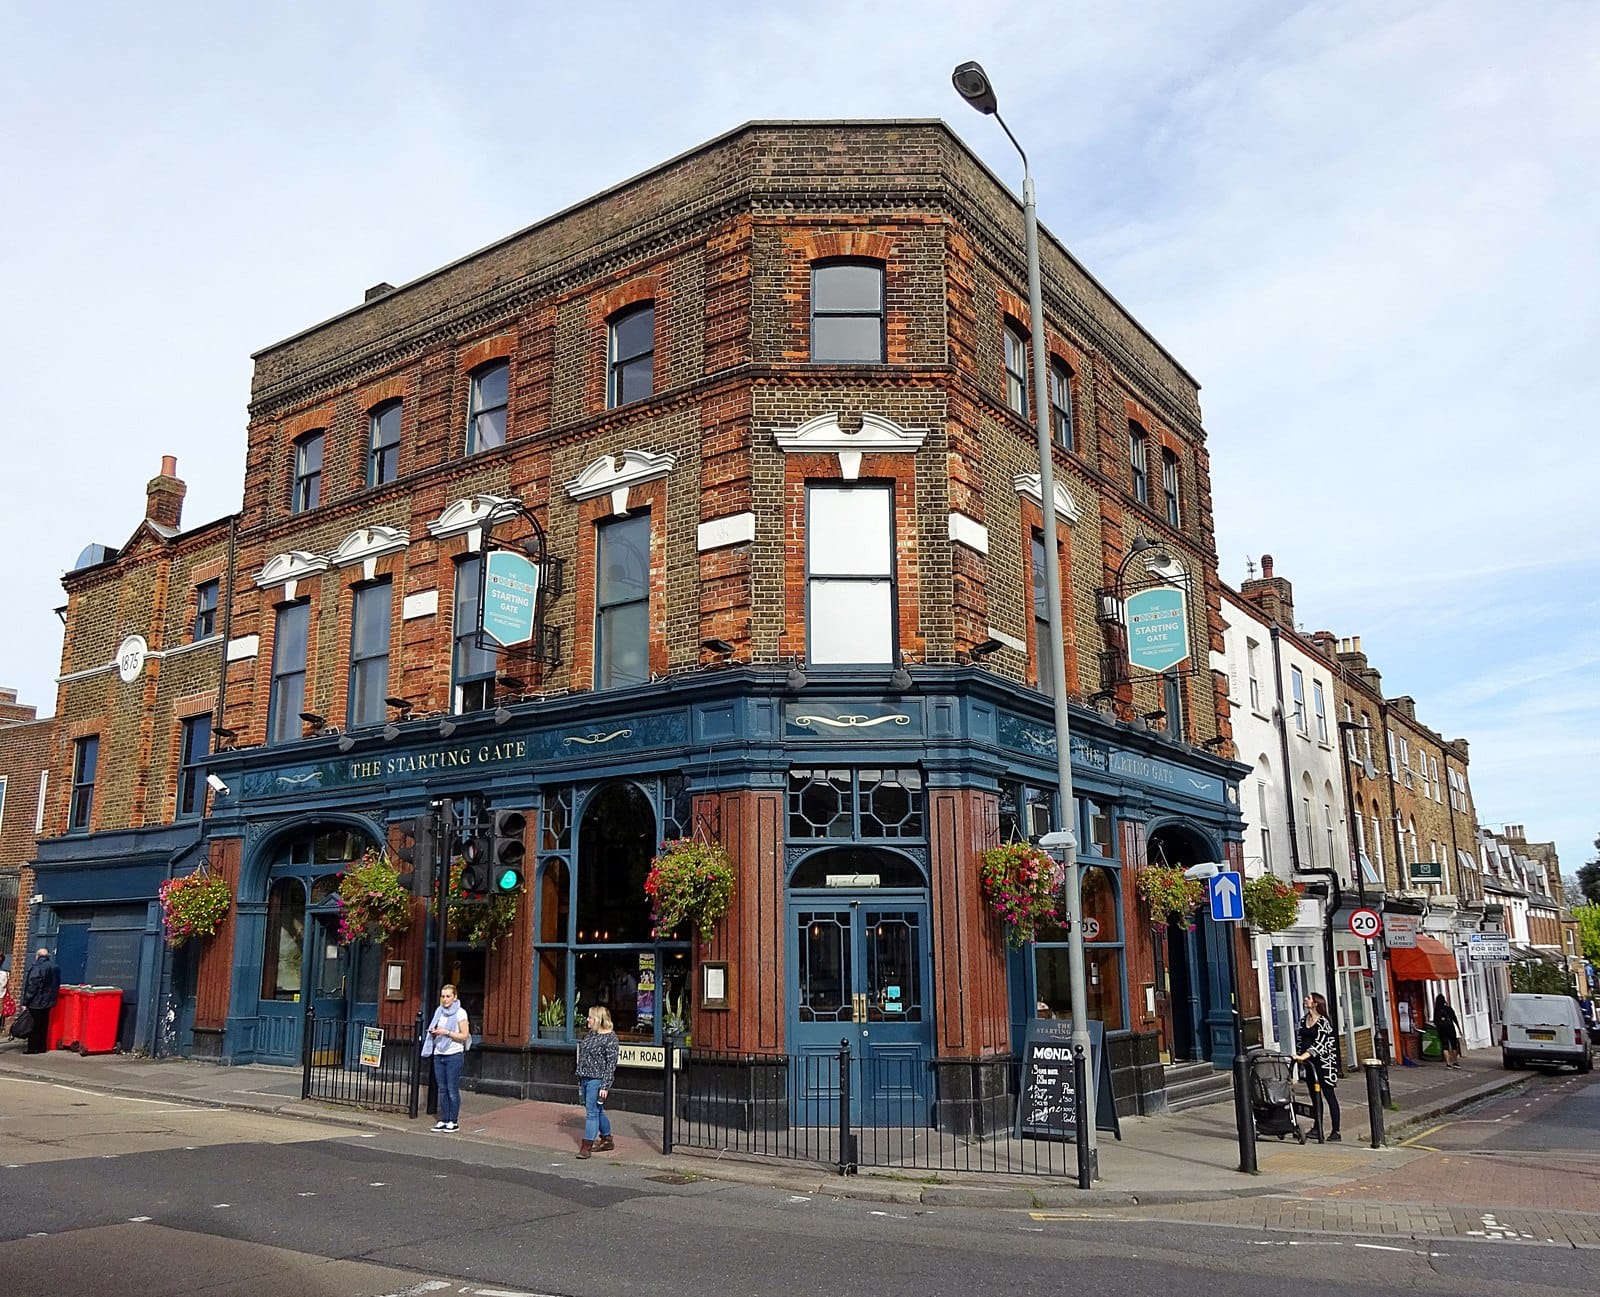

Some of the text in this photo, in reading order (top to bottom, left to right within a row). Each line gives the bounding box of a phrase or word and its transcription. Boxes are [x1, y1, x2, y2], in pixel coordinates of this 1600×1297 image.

[491, 590, 529, 607] STARTING
[500, 603, 518, 614] GATE
[1135, 622, 1179, 635] STARTING
[1147, 634, 1168, 642] GATE
[121, 652, 140, 671] 1875
[351, 741, 526, 778] THE STARTING GATE
[1152, 765, 1174, 784] GATE
[1354, 917, 1376, 929] 20
[618, 1050, 664, 1063] HAM ROAD
